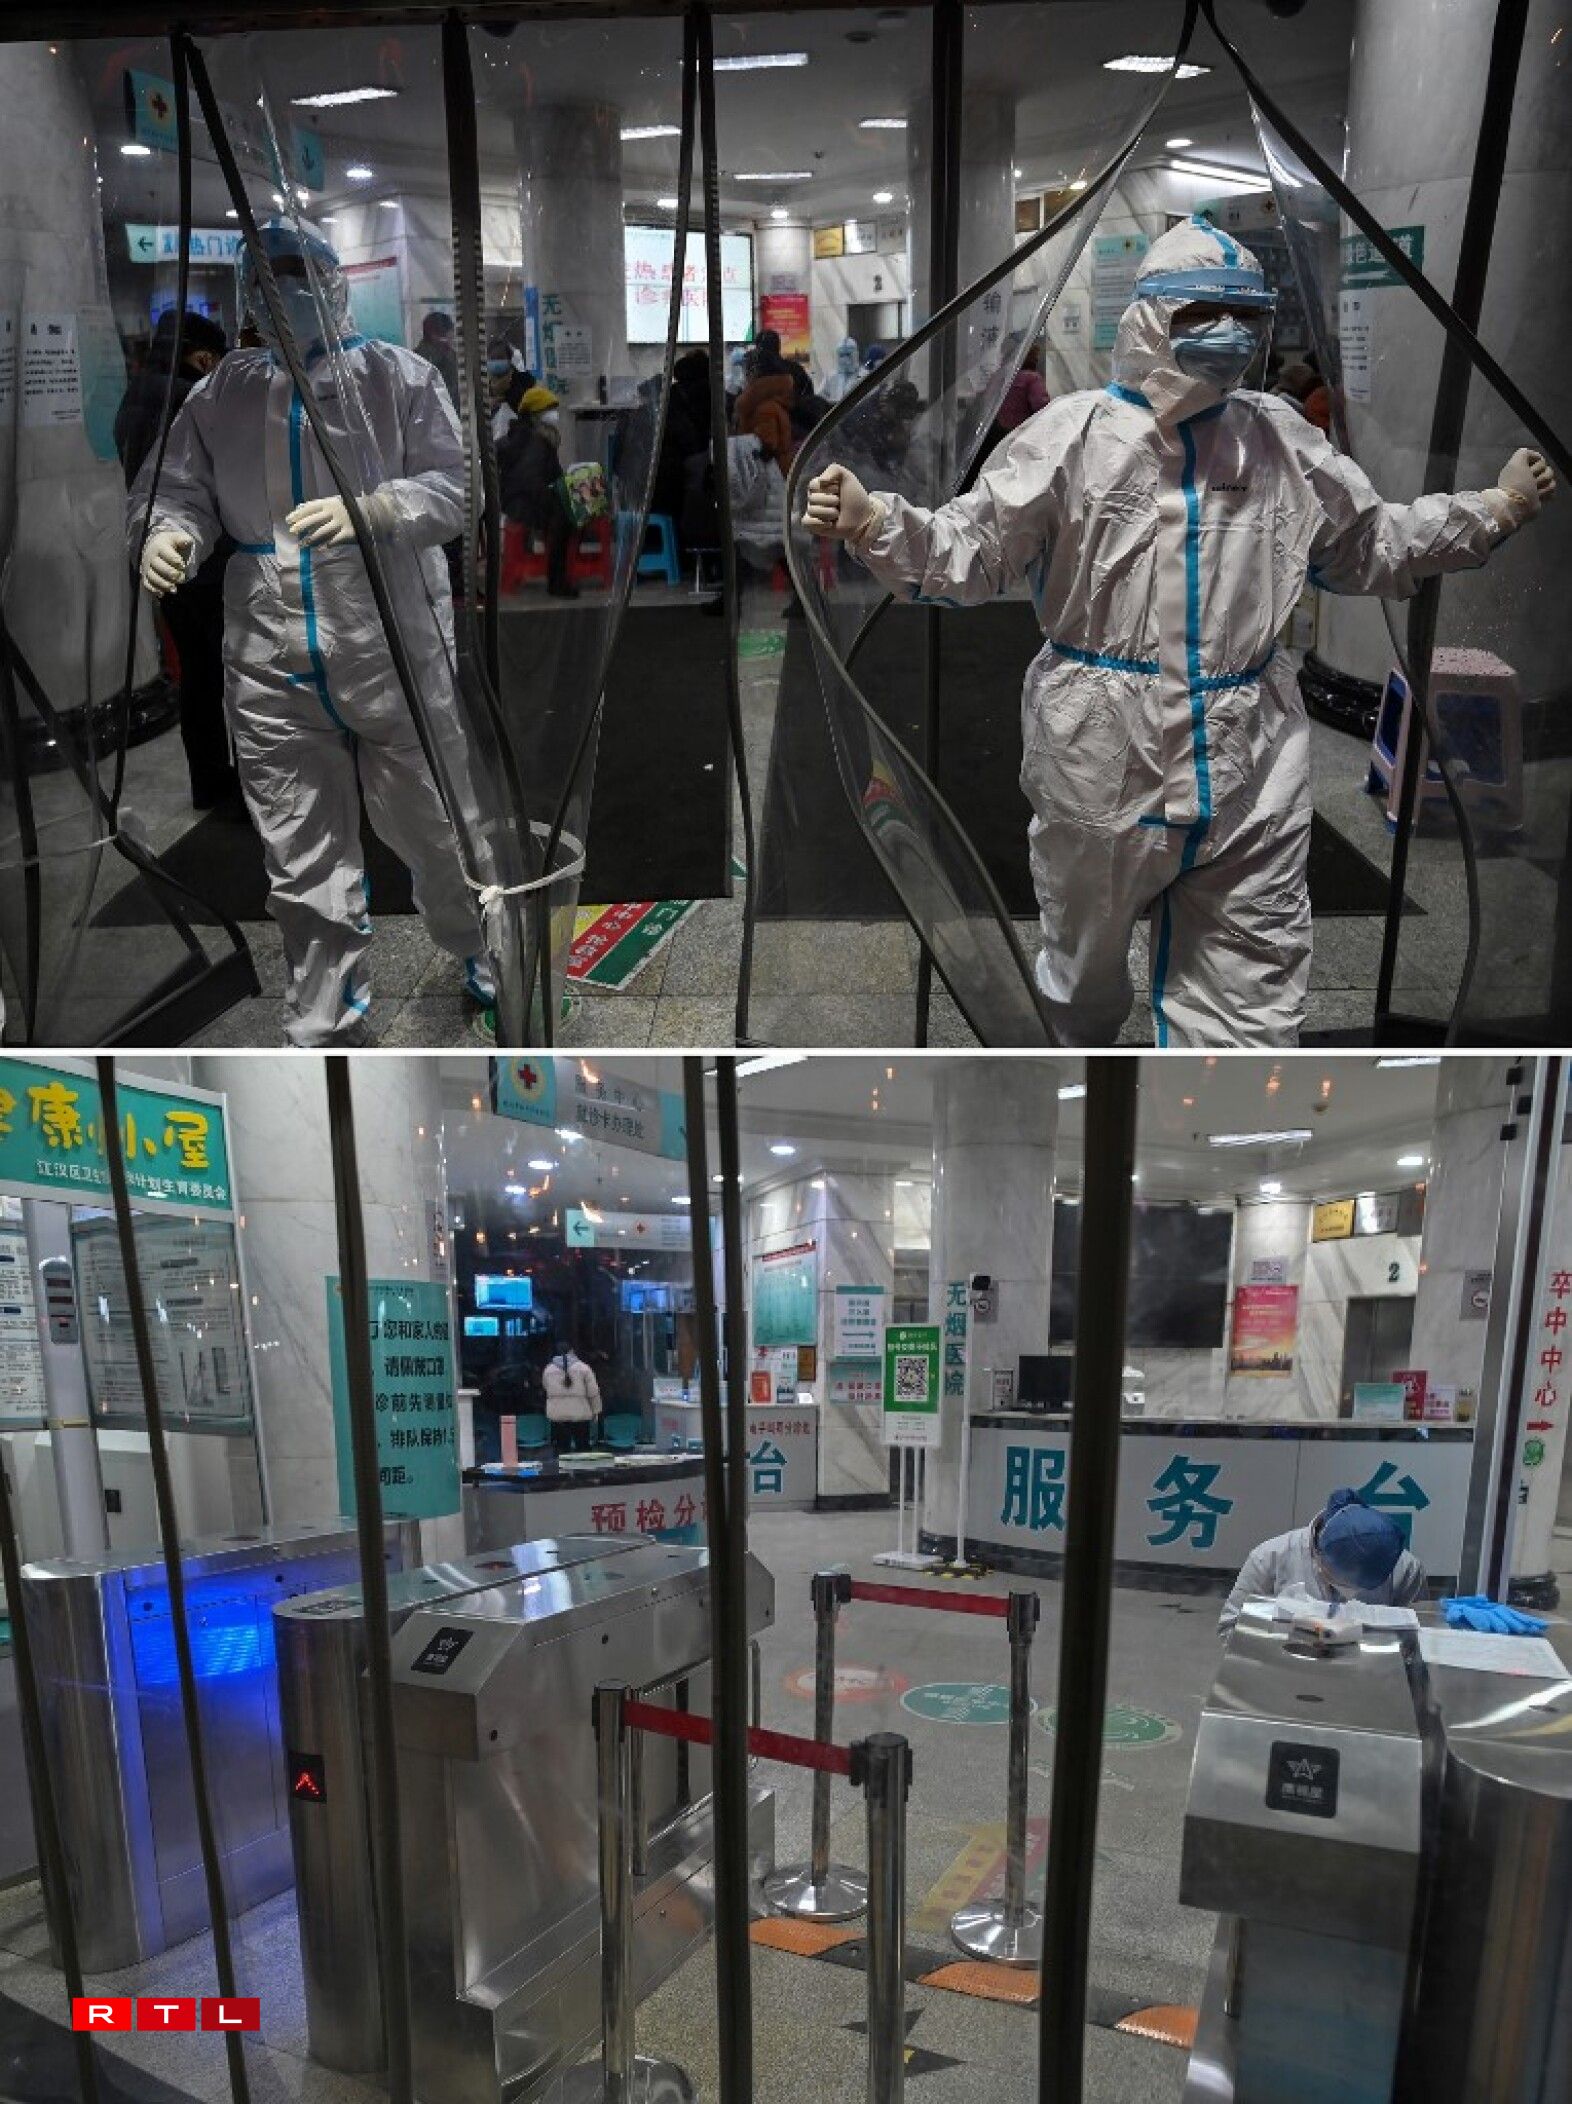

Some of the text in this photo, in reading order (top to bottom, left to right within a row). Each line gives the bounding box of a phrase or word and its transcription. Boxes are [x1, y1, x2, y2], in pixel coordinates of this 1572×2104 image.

[1387, 1262, 1400, 1283] 2
[944, 1282, 967, 1396] 无烟医院
[1534, 1270, 1572, 1408] 卒中中心
[592, 1493, 708, 1532] 预检分
